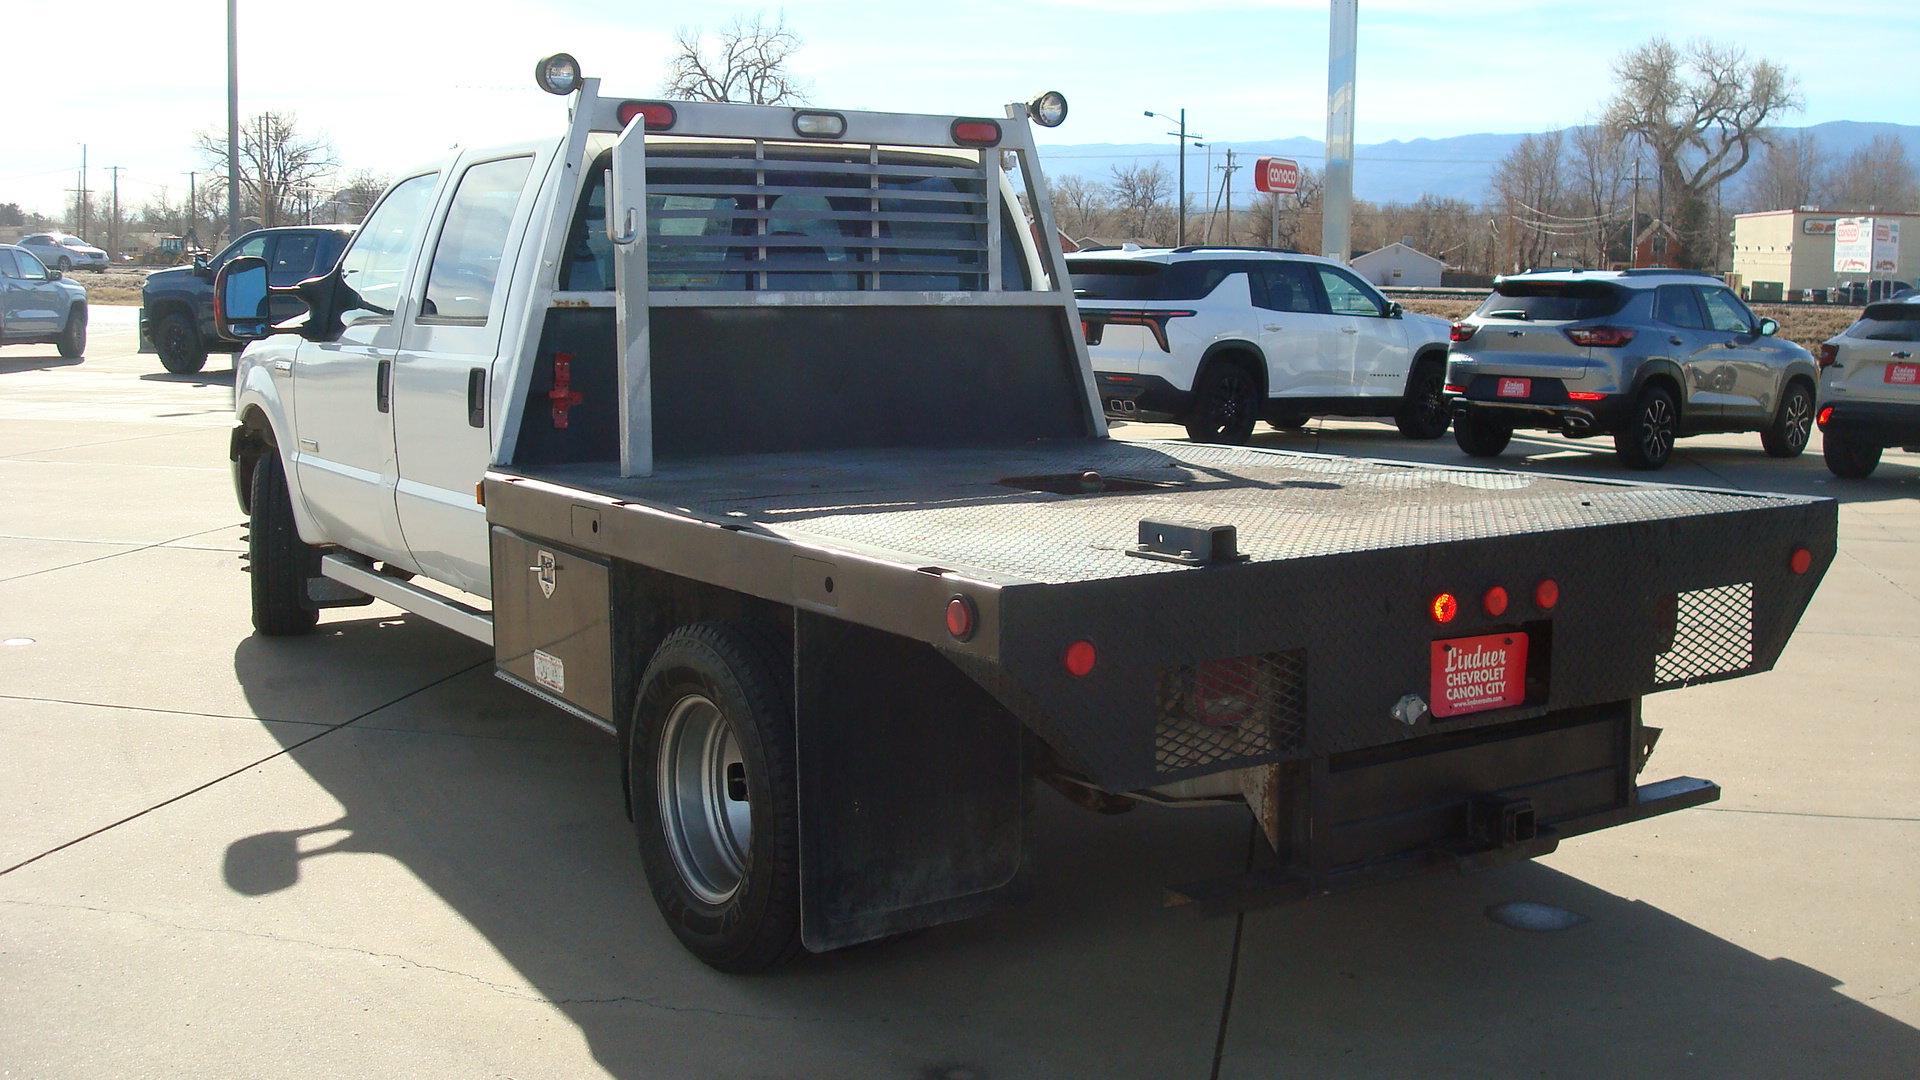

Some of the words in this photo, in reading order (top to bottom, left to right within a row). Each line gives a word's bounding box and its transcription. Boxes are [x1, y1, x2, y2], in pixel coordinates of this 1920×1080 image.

[1445, 644, 1507, 672] Lindner
[1446, 667, 1505, 687] CHEVROLET
[1446, 686, 1483, 701] CANON
[1485, 681, 1507, 694] CITY
